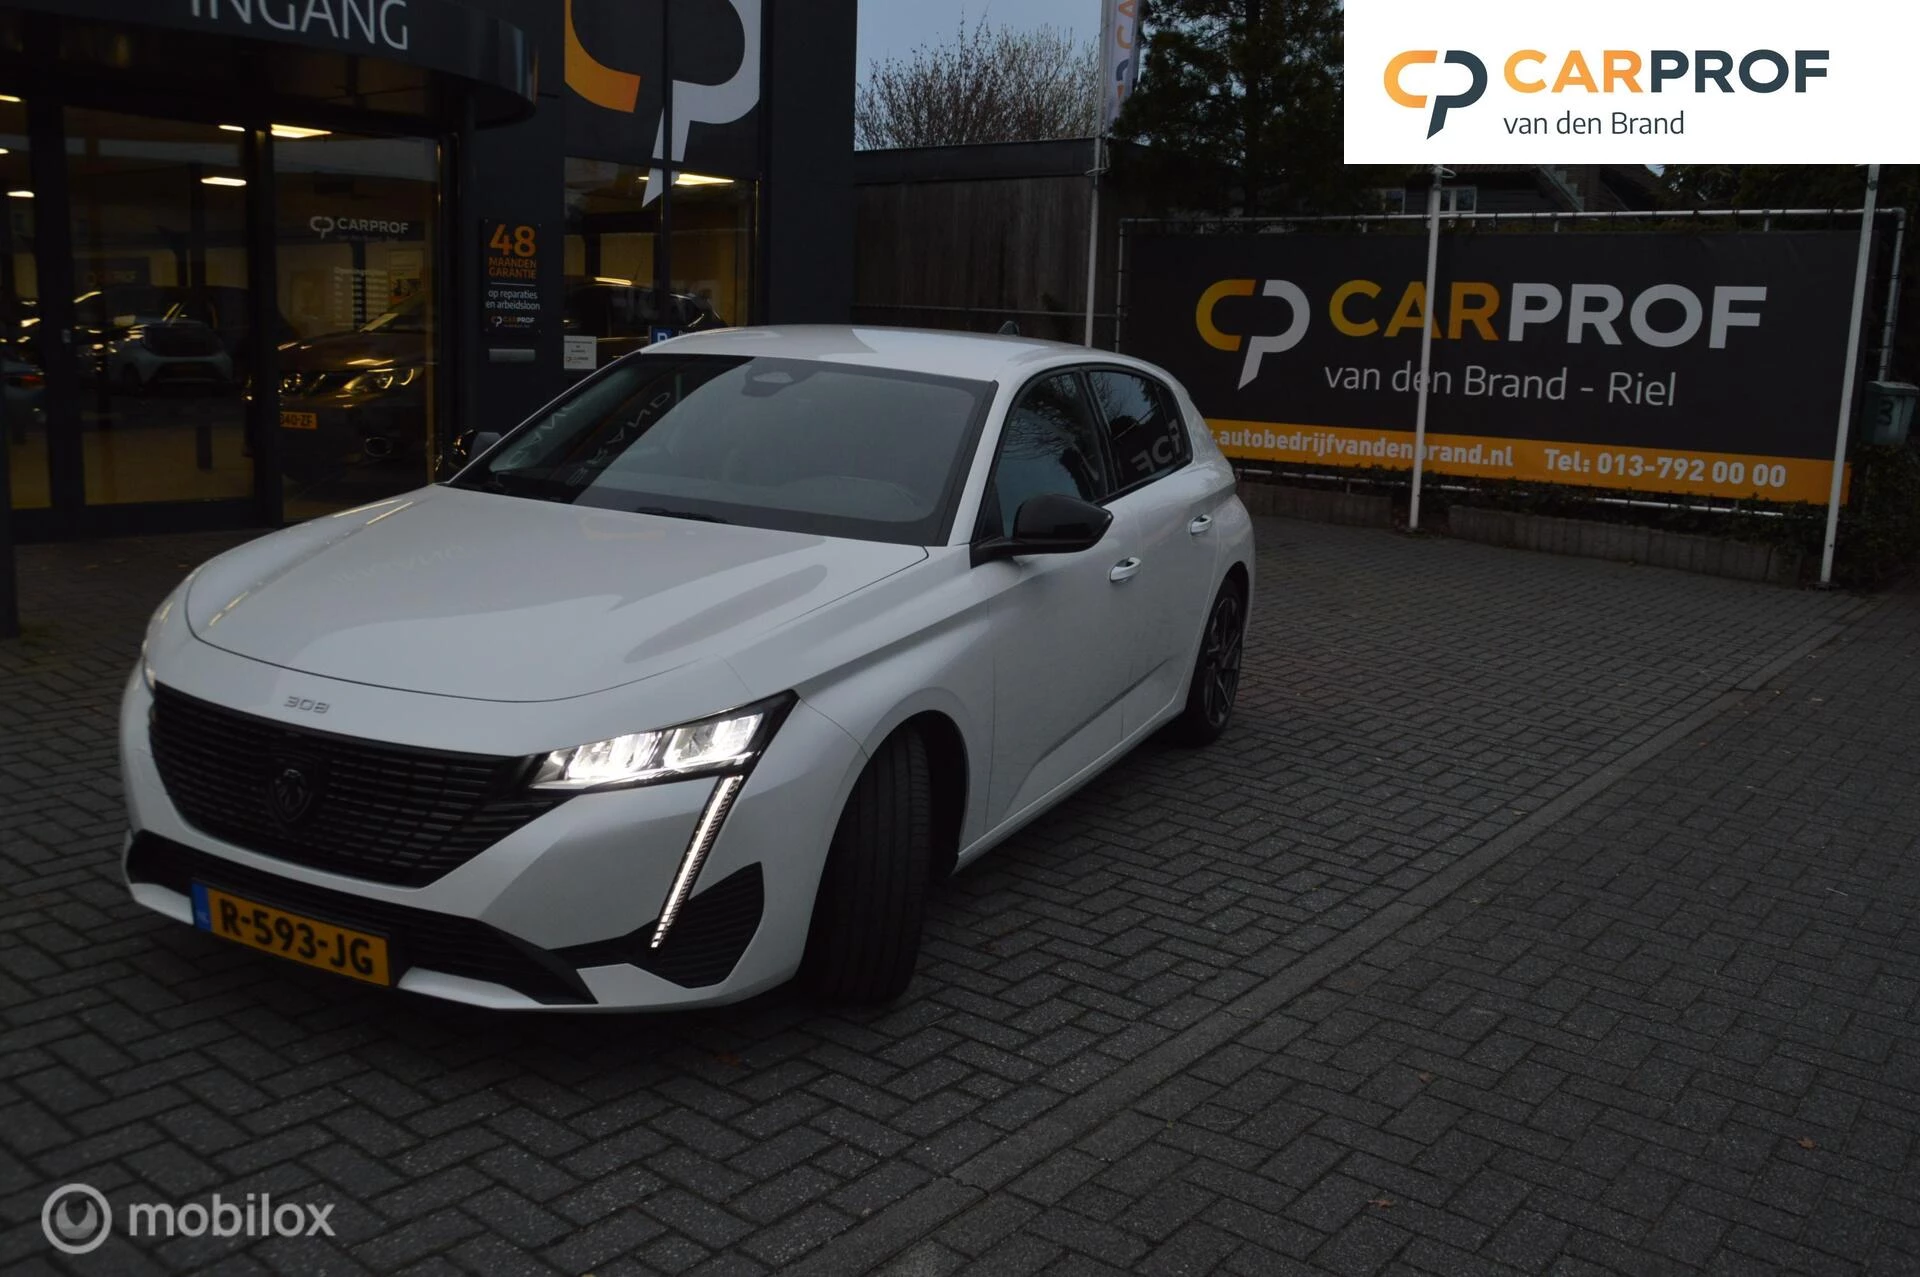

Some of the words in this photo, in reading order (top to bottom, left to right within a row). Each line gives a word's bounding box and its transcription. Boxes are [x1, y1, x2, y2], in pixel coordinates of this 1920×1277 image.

[337, 217, 409, 234] CARPROF
[489, 223, 537, 257] 48
[489, 256, 537, 269] MAANDEN
[489, 266, 537, 280] GARANTIE
[488, 290, 499, 300] op
[500, 289, 538, 300] reparaties
[485, 301, 496, 310] en
[497, 300, 541, 310] arbeidsloon
[1329, 278, 1767, 349] CARPROF
[1324, 365, 1381, 391] van
[1391, 359, 1452, 395] den
[1463, 364, 1568, 401] Brand
[1608, 371, 1677, 407] Riel
[1544, 448, 1590, 474] Tel:
[1597, 451, 1705, 482] 013-792
[1711, 460, 1745, 485] 00
[1752, 463, 1787, 489] 00
[283, 695, 330, 714] 308
[219, 898, 374, 975] R-593-JG
